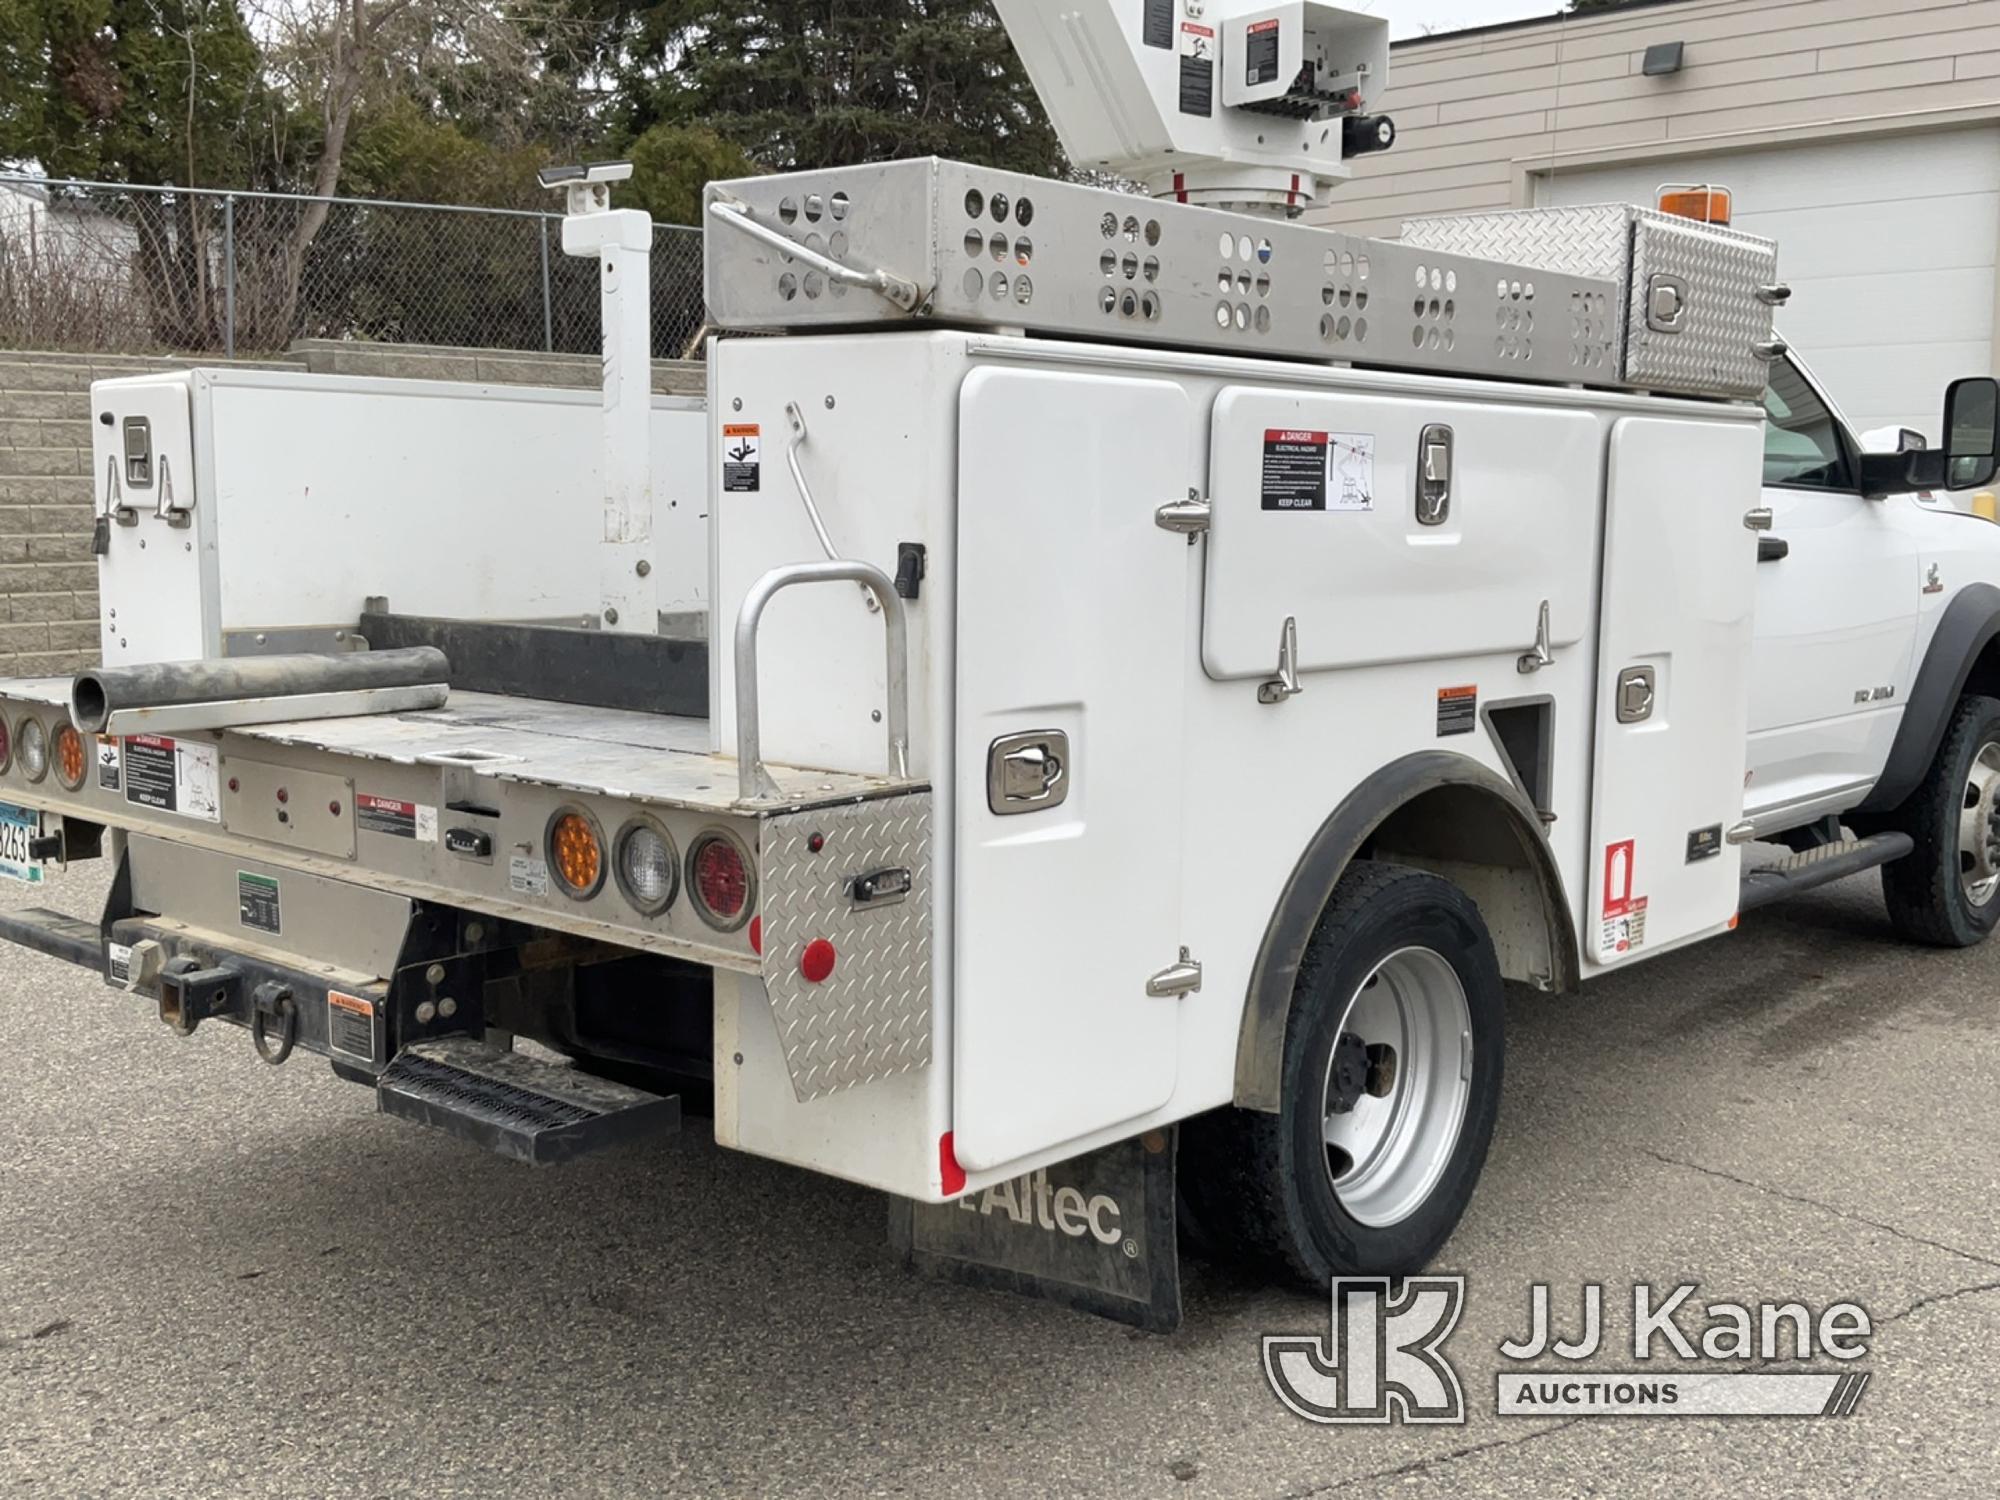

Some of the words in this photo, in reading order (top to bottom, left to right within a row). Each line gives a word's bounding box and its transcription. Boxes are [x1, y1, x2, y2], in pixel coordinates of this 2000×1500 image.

[1286, 432, 1312, 441] DANGER
[1278, 498, 1293, 507] KEEP
[1294, 498, 1312, 507] CLEAR
[377, 799, 402, 812] DANGER
[980, 1166, 1122, 1245] Altec
